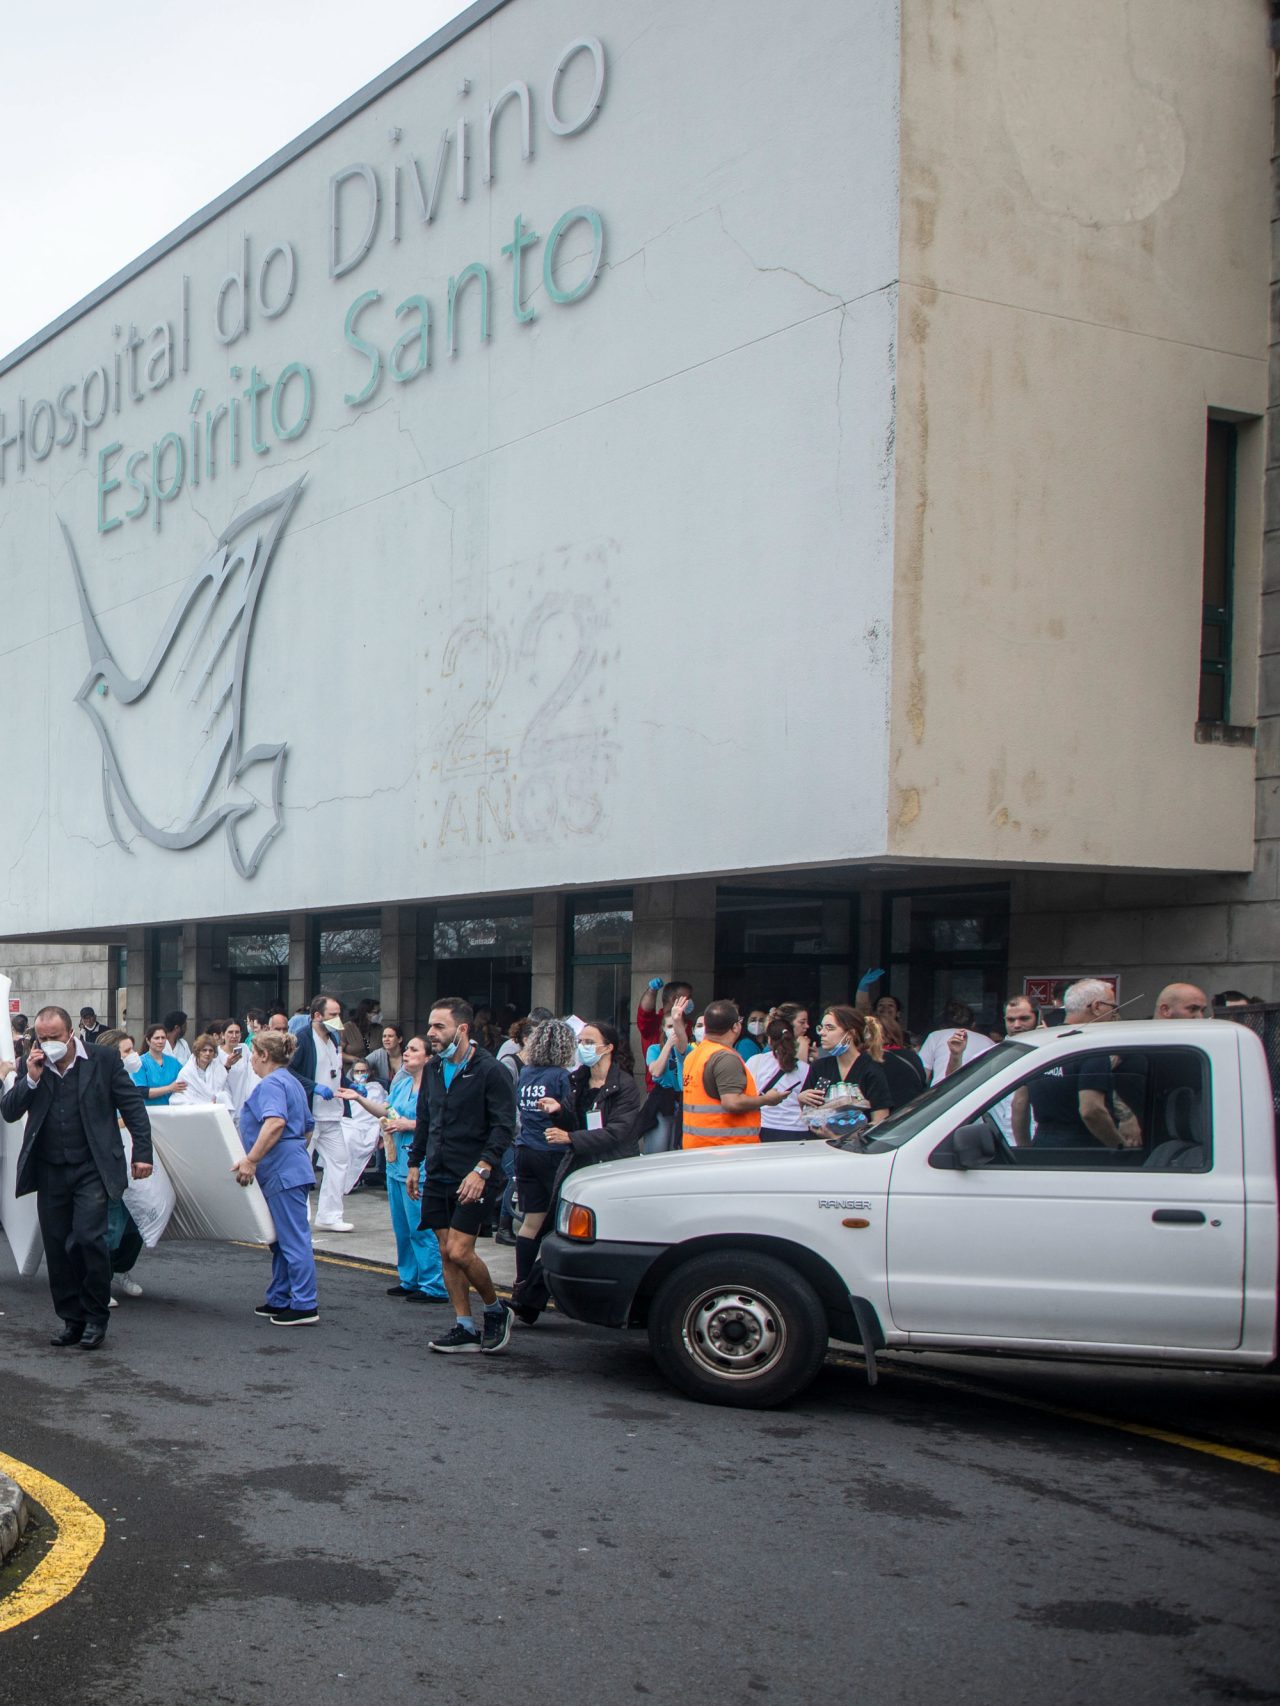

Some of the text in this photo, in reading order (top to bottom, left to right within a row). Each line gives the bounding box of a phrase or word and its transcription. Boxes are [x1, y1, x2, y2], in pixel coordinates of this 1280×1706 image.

[217, 231, 297, 346] do
[329, 36, 607, 279] Divino
[97, 205, 605, 533] Espírito Santo
[440, 590, 598, 782] 22
[520, 1085, 546, 1097] 1133
[818, 1199, 872, 1210] RANGER
